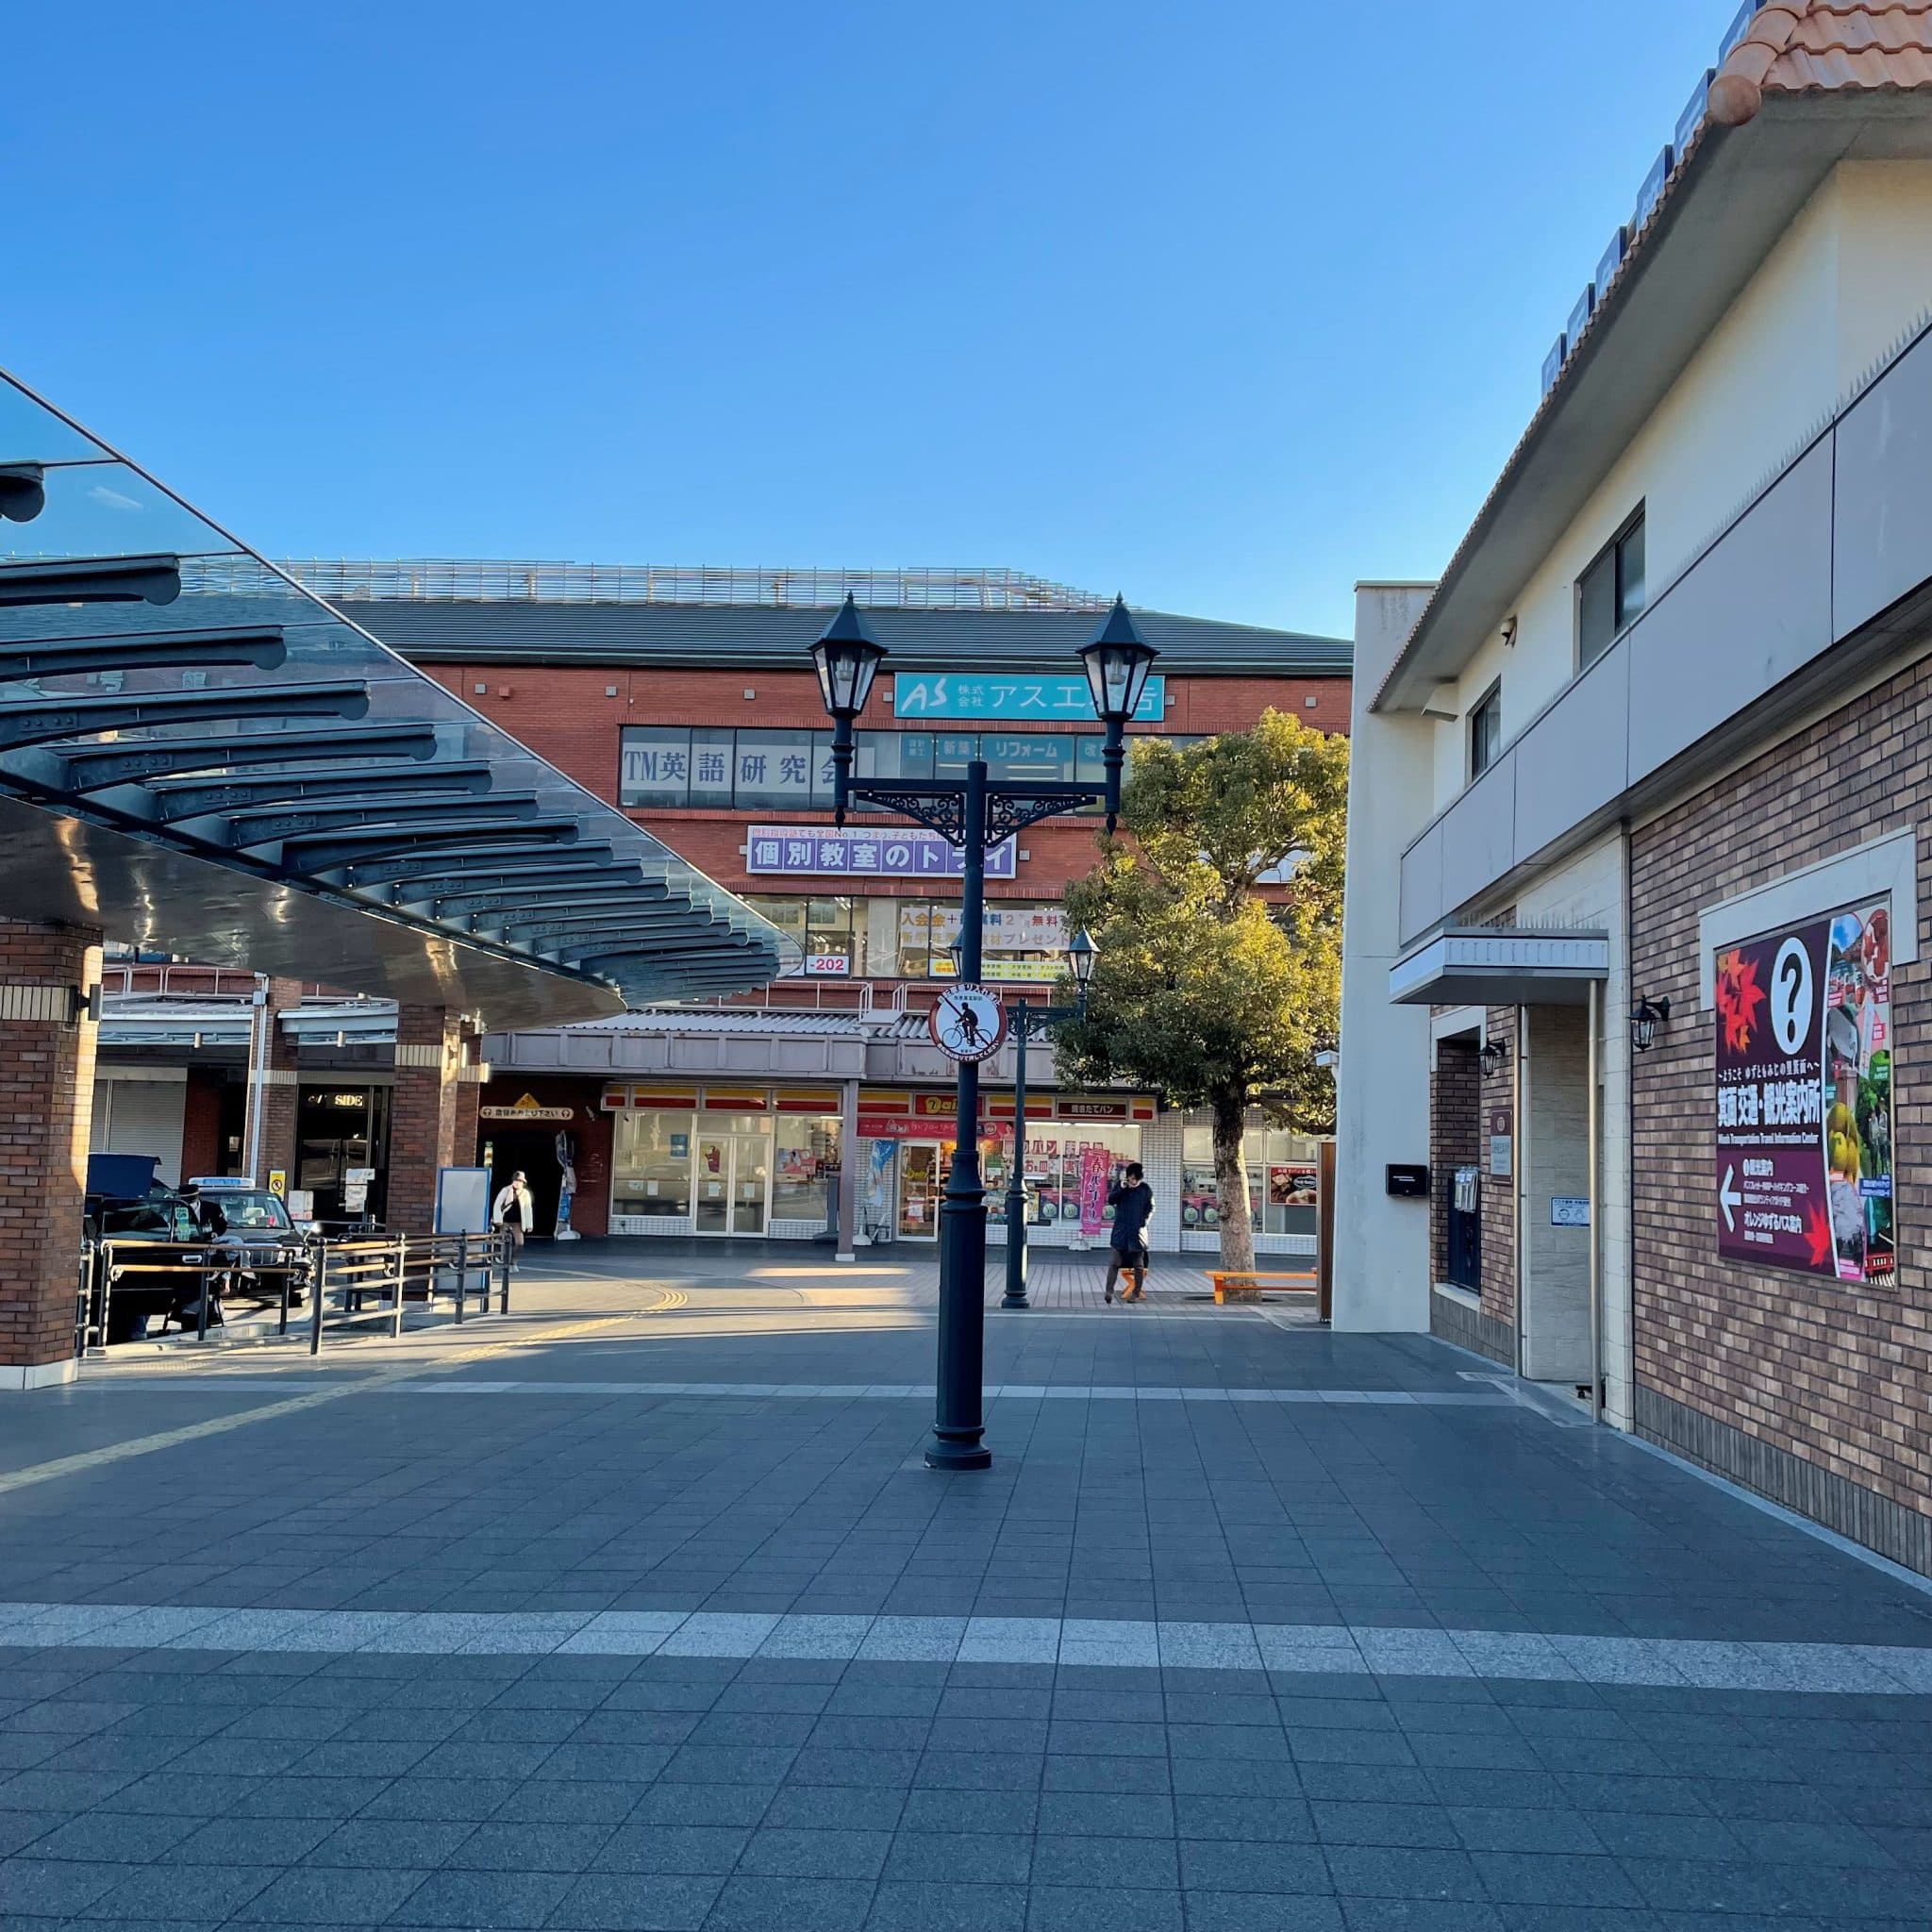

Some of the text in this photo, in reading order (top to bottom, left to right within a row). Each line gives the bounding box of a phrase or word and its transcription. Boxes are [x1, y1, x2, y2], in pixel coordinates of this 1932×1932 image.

[901, 677, 948, 712] AS
[958, 684, 983, 695] 株式
[958, 696, 983, 708] 会社
[996, 741, 1058, 758] リフォーム
[1085, 742, 1105, 757] 改
[335, 1094, 363, 1107] SIDE
